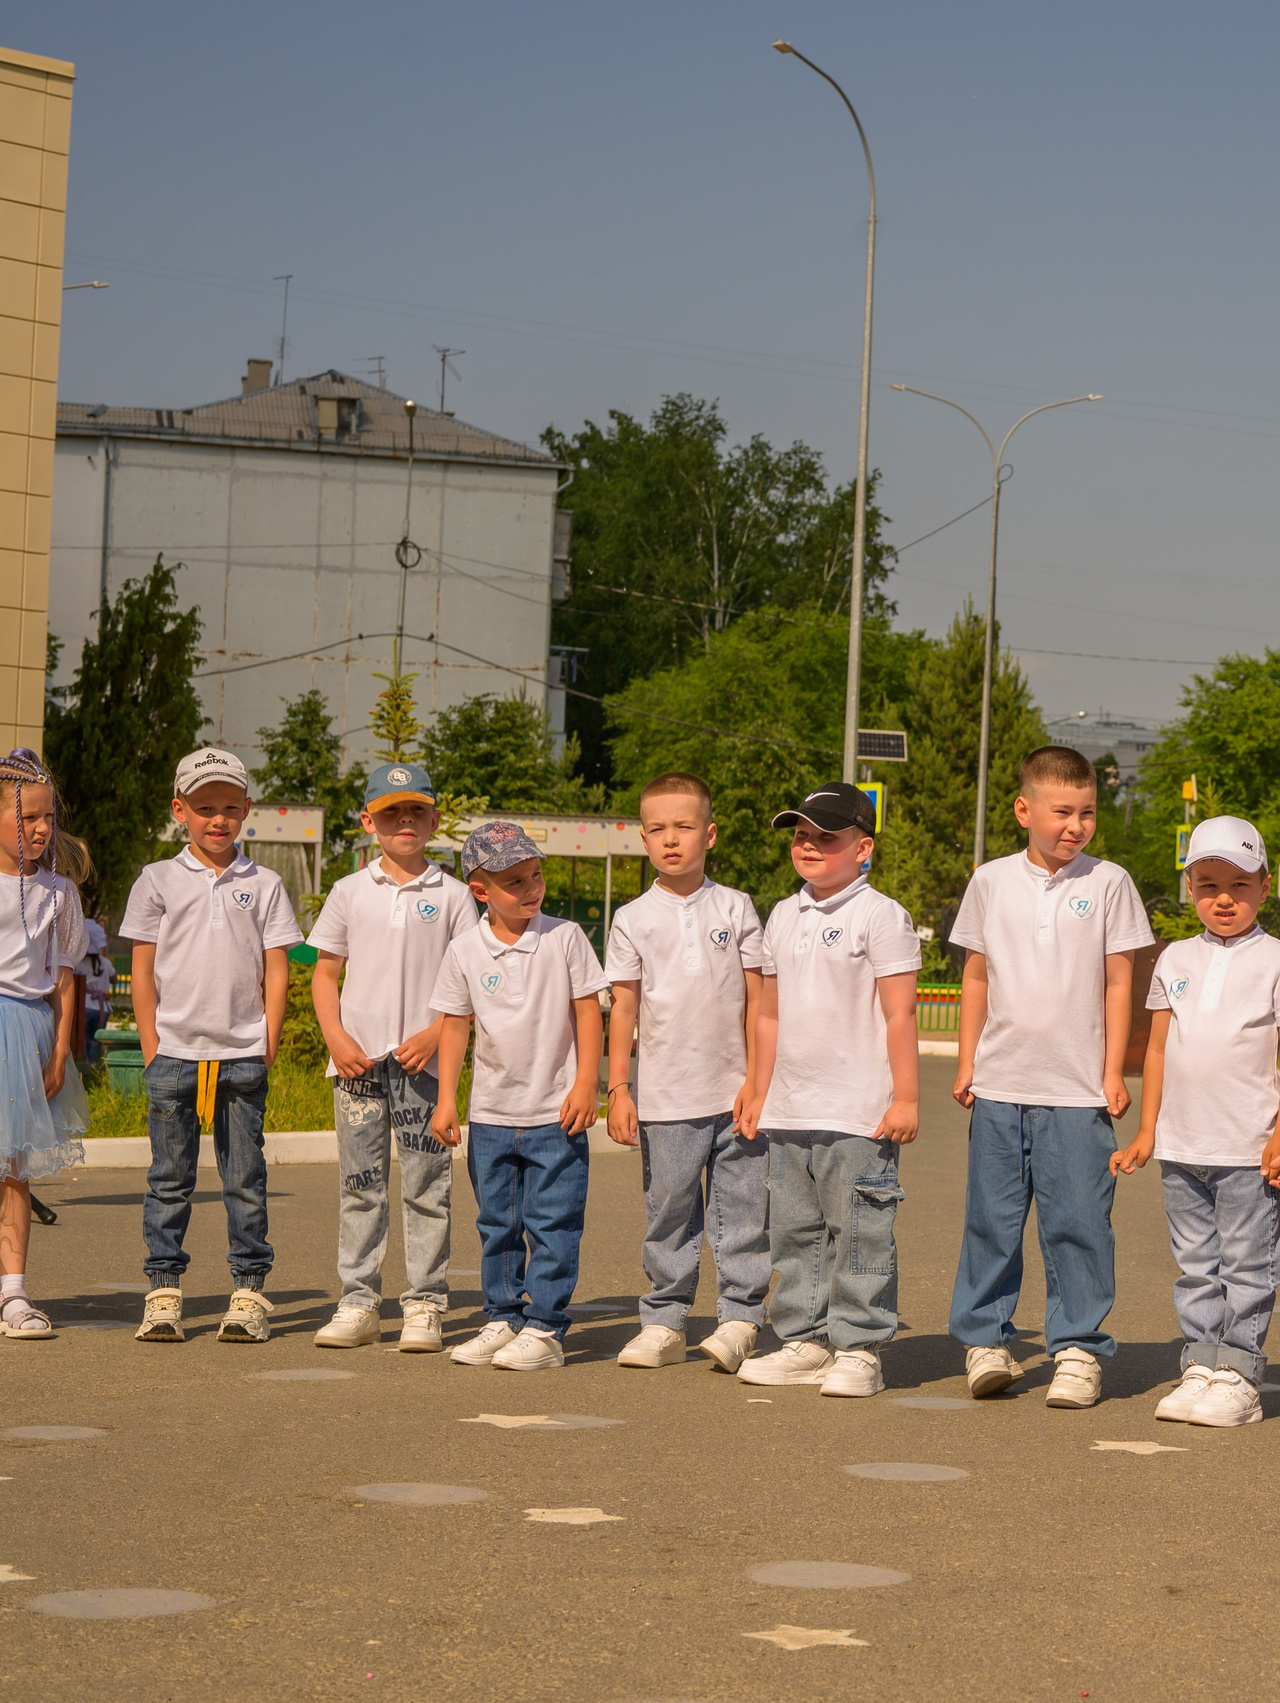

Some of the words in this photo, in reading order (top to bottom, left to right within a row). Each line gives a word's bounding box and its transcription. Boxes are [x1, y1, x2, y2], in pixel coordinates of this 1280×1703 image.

[194, 757, 229, 769] Reebok
[402, 1131, 441, 1155] BAND
[347, 1169, 374, 1191] STAR
